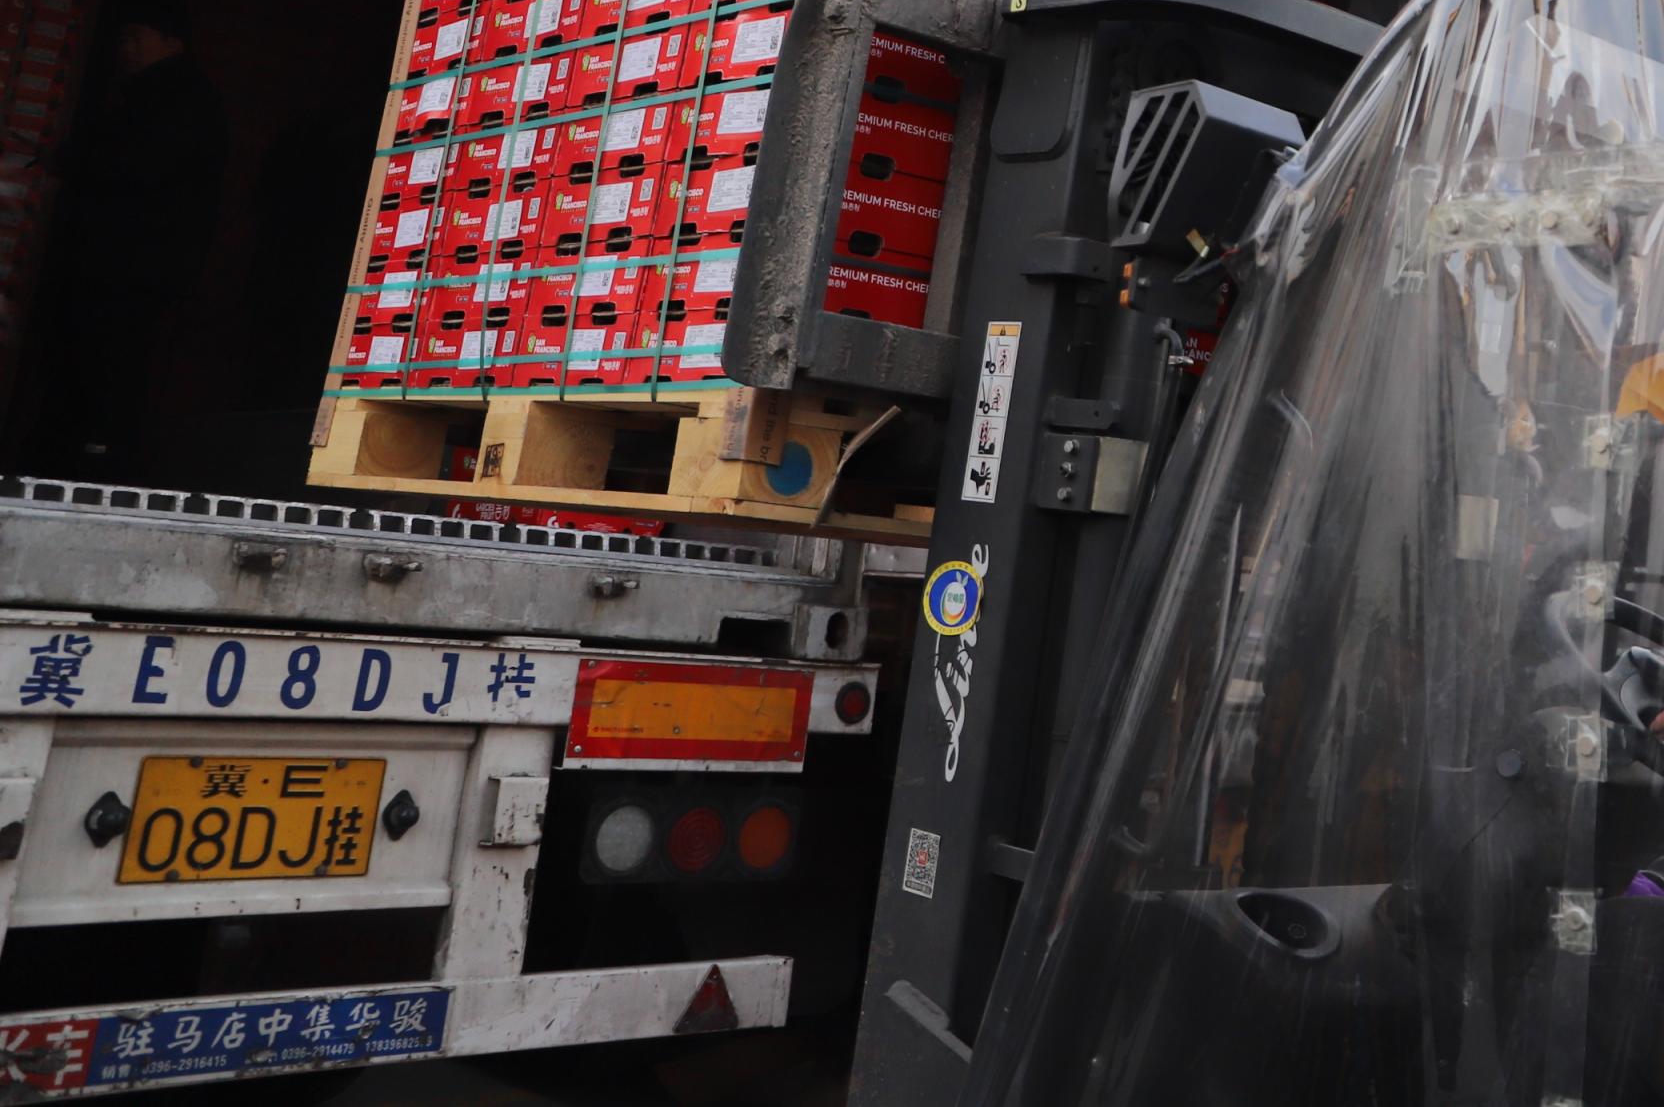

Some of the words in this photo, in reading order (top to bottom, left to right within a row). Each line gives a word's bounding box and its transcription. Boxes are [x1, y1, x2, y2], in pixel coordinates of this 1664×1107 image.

[871, 37, 903, 53] EMIUM
[905, 47, 937, 64] FRESH
[858, 113, 893, 130] EMIUM
[894, 122, 927, 139] FRESH
[883, 199, 916, 214] FRESH
[870, 274, 903, 290] FRESH
[138, 806, 363, 872] 08DJ挂
[113, 997, 428, 1059] 驻马店中集华骏
